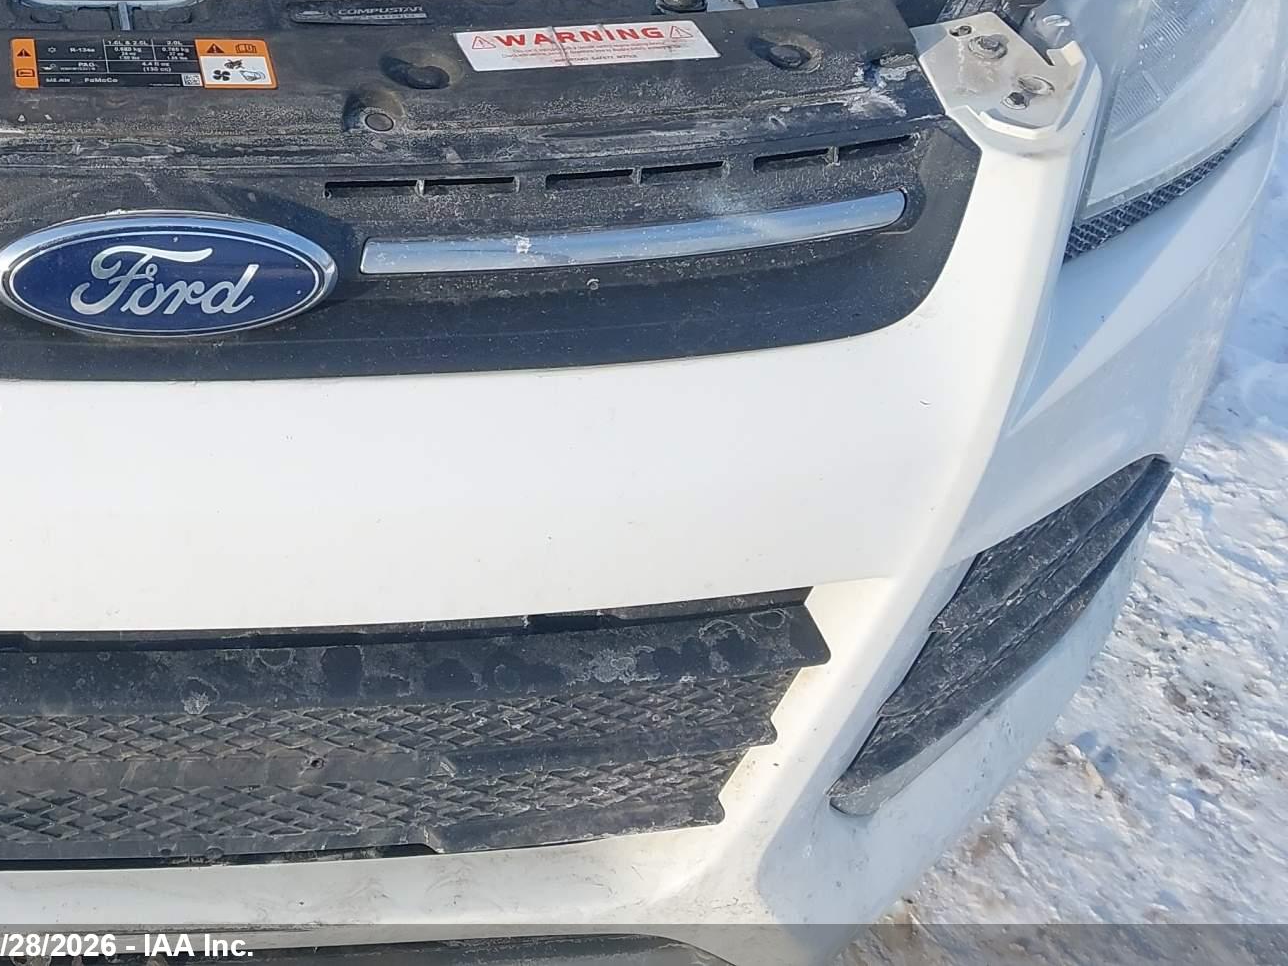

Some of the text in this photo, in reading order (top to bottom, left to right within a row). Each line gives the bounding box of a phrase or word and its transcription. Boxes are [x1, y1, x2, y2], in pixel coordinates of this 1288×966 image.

[338, 6, 424, 16] COMPUSTAR
[494, 27, 665, 48] WARNING
[70, 245, 260, 315] Ford
